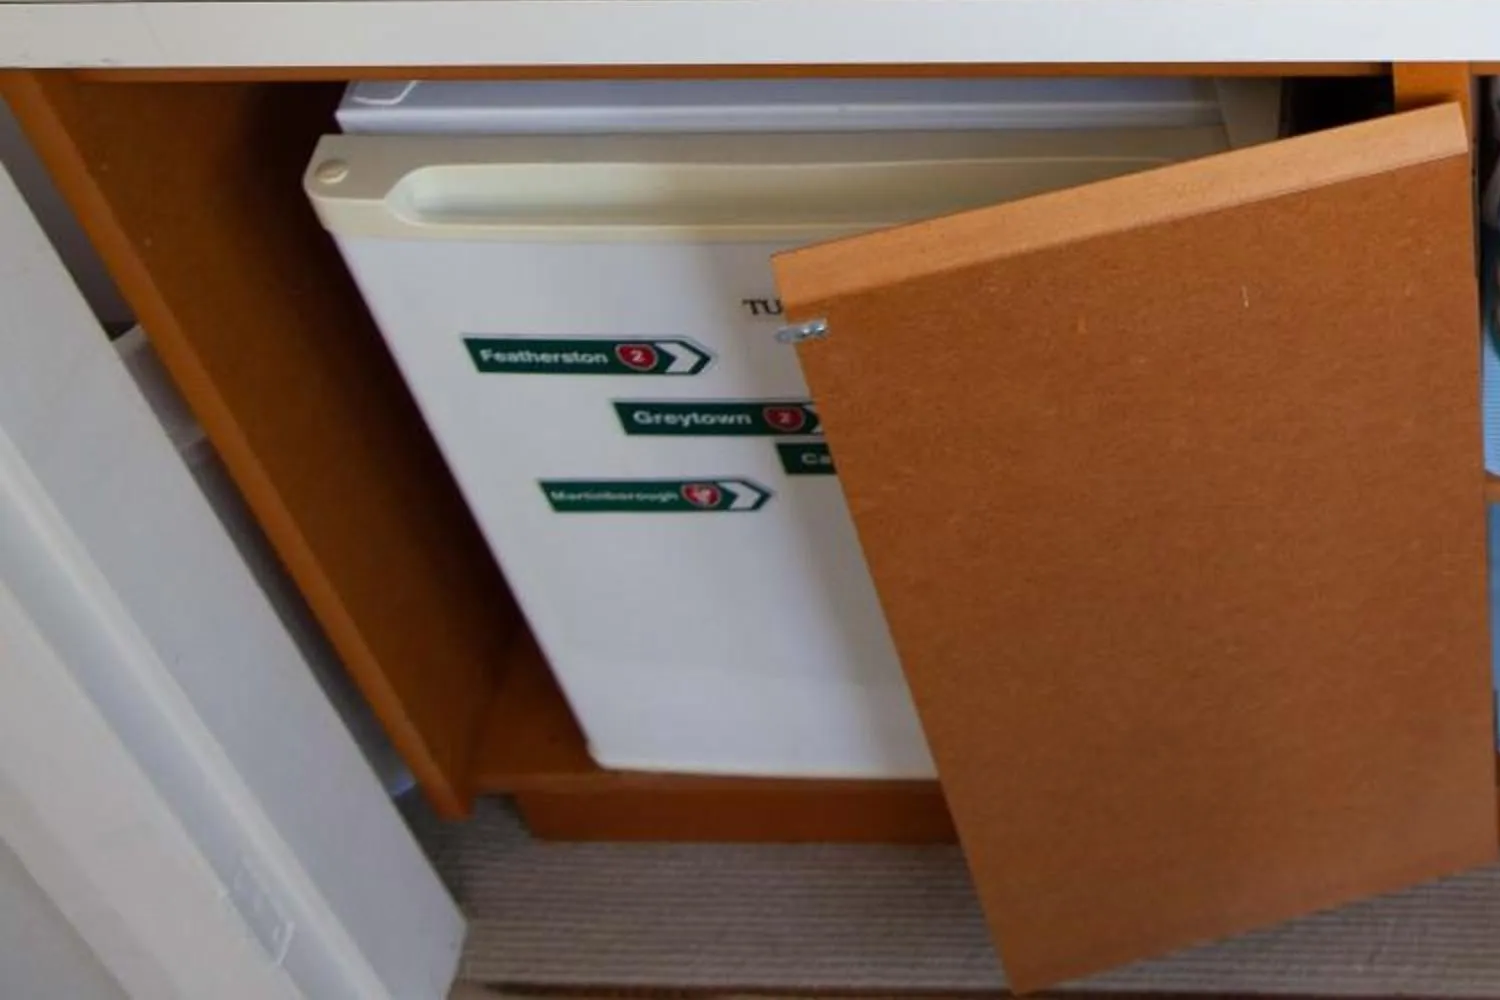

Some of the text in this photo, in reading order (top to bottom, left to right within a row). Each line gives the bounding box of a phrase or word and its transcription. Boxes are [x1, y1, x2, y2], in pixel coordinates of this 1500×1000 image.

[479, 349, 645, 365] Featherston 2
[632, 410, 792, 427] Greytown 2
